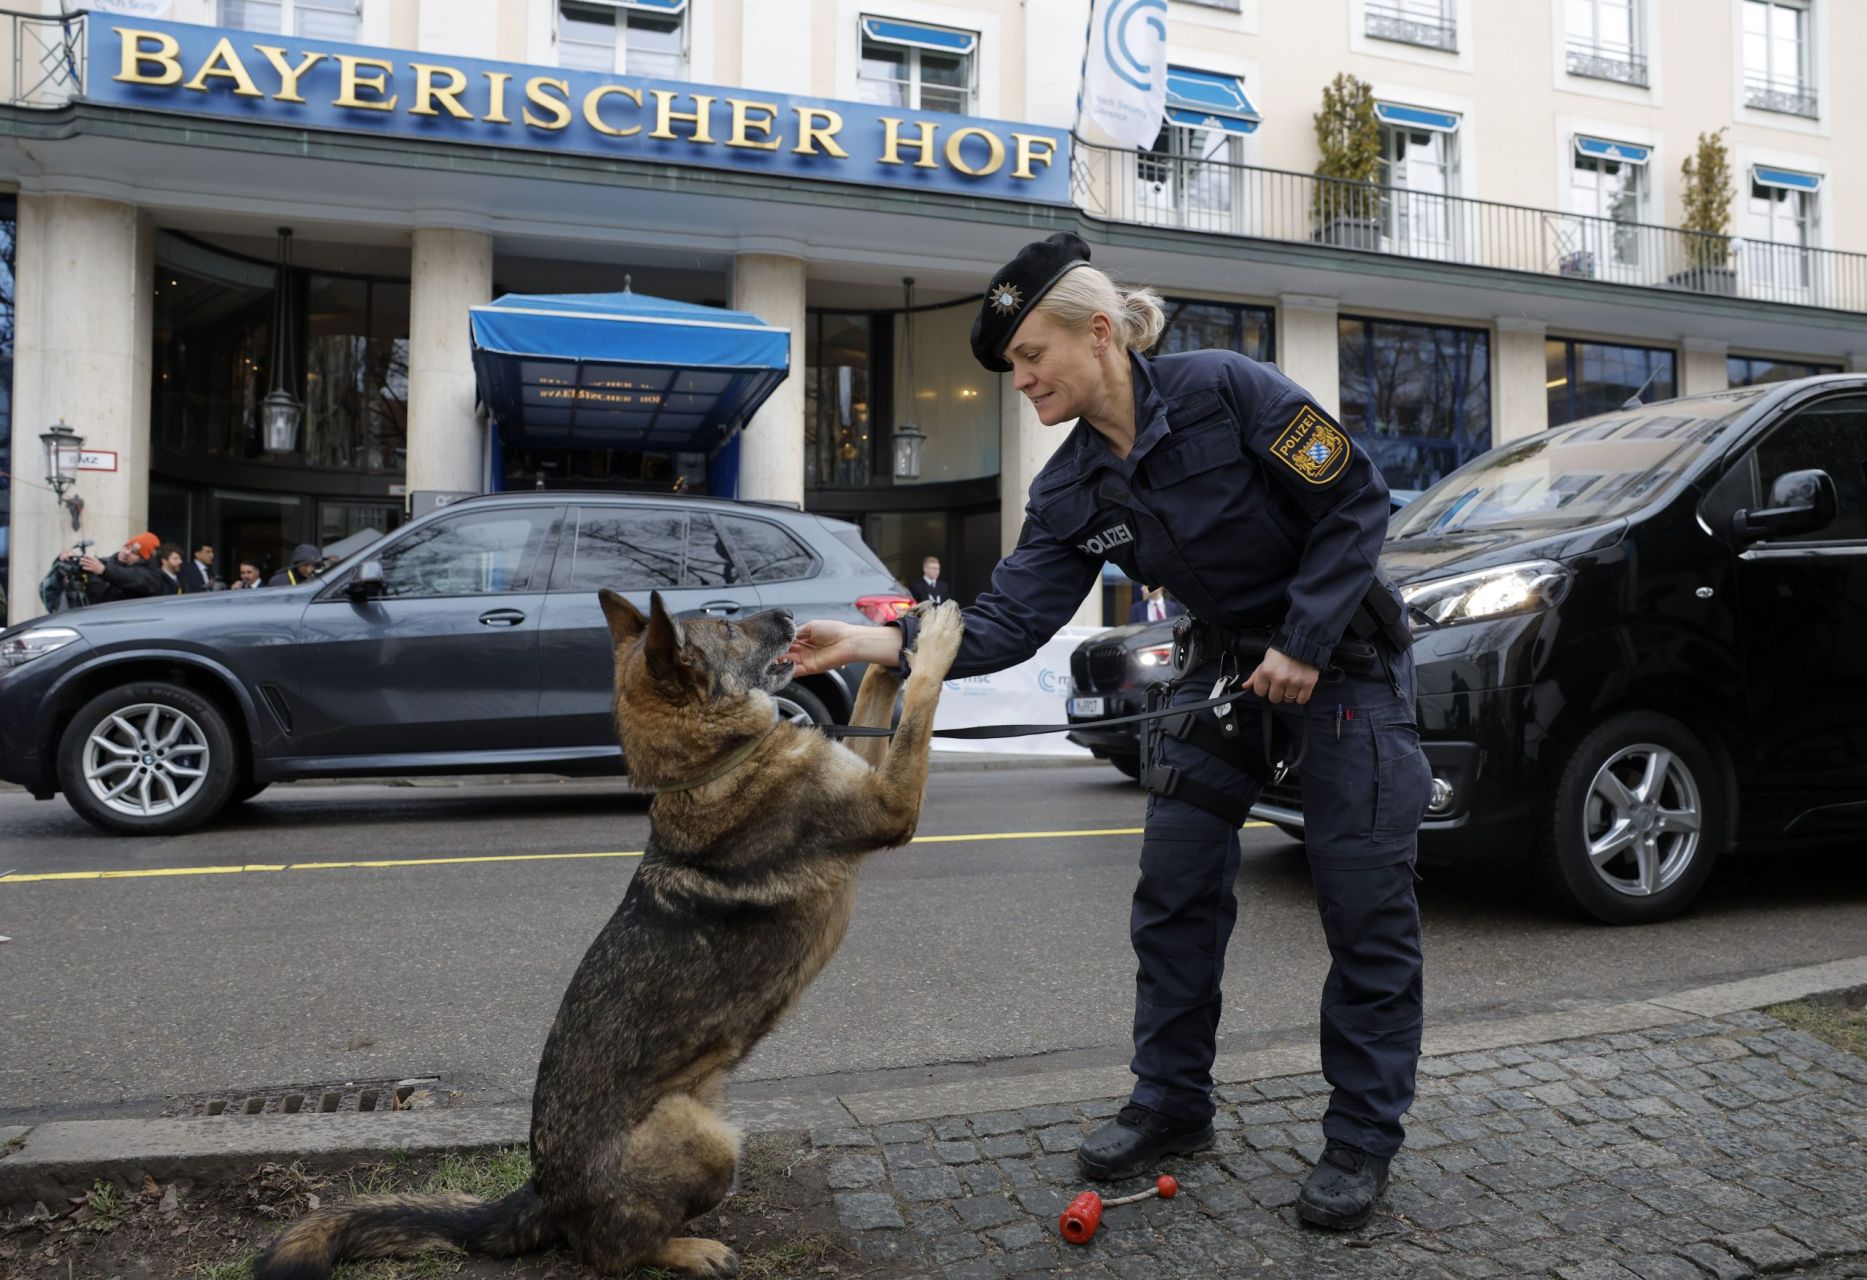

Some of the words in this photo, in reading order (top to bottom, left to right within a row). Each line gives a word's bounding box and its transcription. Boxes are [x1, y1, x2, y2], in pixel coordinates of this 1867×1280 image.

[111, 26, 848, 159] BAYERISCHER
[876, 116, 1057, 179] HOF
[1280, 414, 1316, 456] POLIZEI
[1076, 523, 1134, 554] POLIZEI
